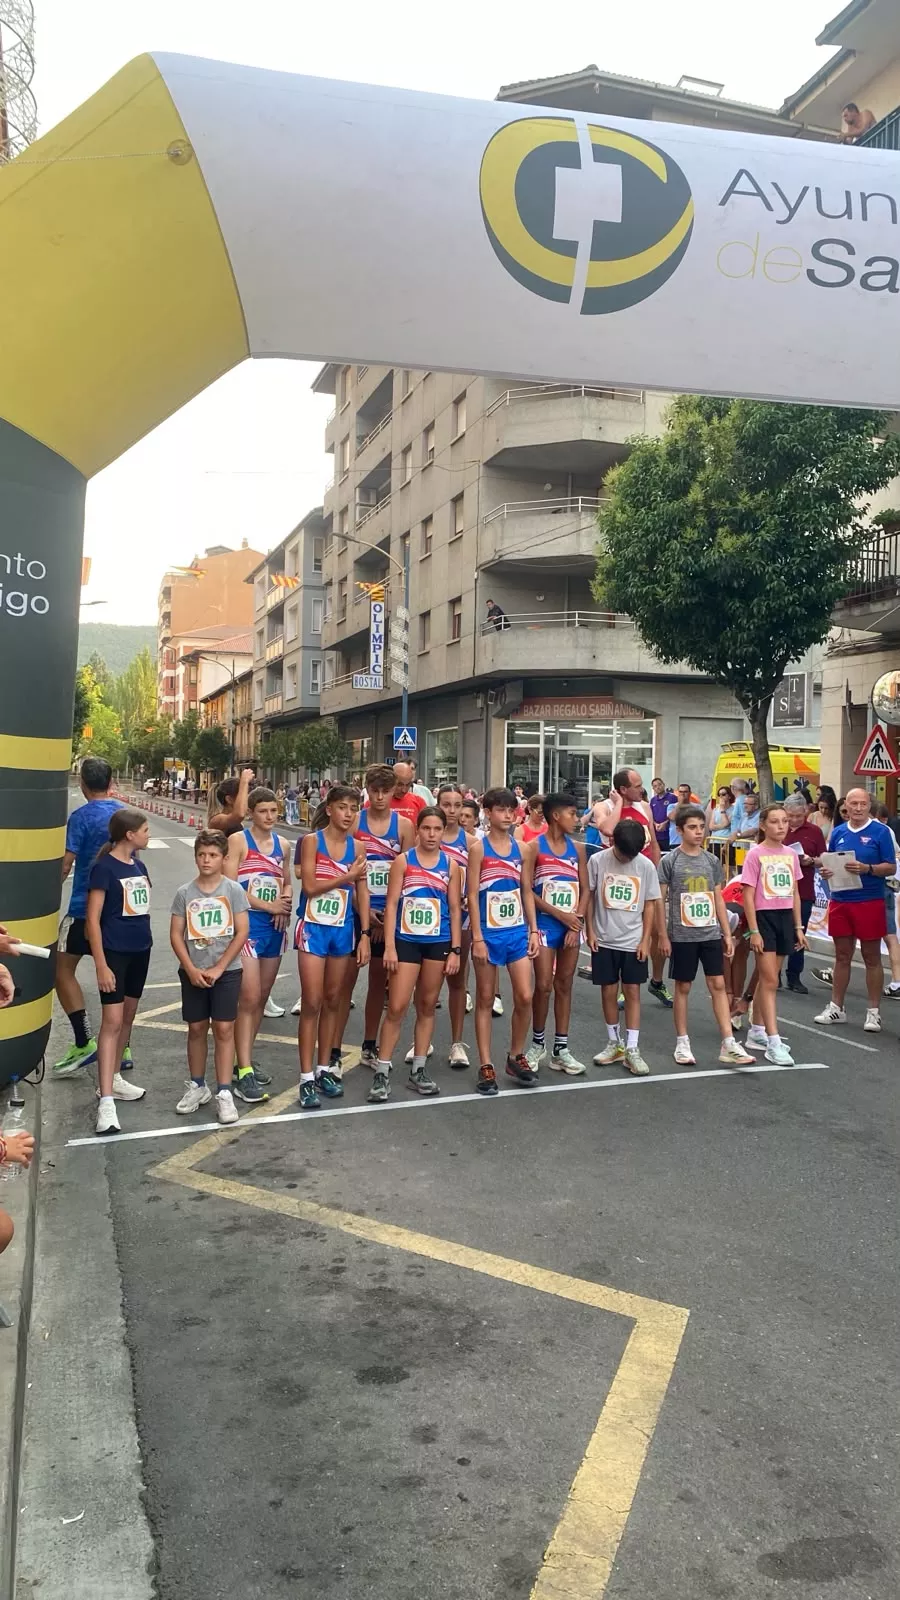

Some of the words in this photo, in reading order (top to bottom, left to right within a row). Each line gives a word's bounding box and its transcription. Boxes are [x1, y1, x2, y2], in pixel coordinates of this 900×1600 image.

[372, 603, 384, 674] OLIMPIC
[523, 703, 551, 717] BAZAR
[553, 703, 587, 717] REGALO
[772, 873, 791, 887] 194
[132, 889, 148, 905] 173
[256, 888, 277, 902] 168
[551, 893, 572, 907] 144
[609, 886, 632, 902] 155
[316, 899, 340, 916] 149
[500, 904, 515, 918] 98
[689, 904, 710, 917] 183
[198, 910, 223, 927] 174
[409, 910, 433, 925] 198
